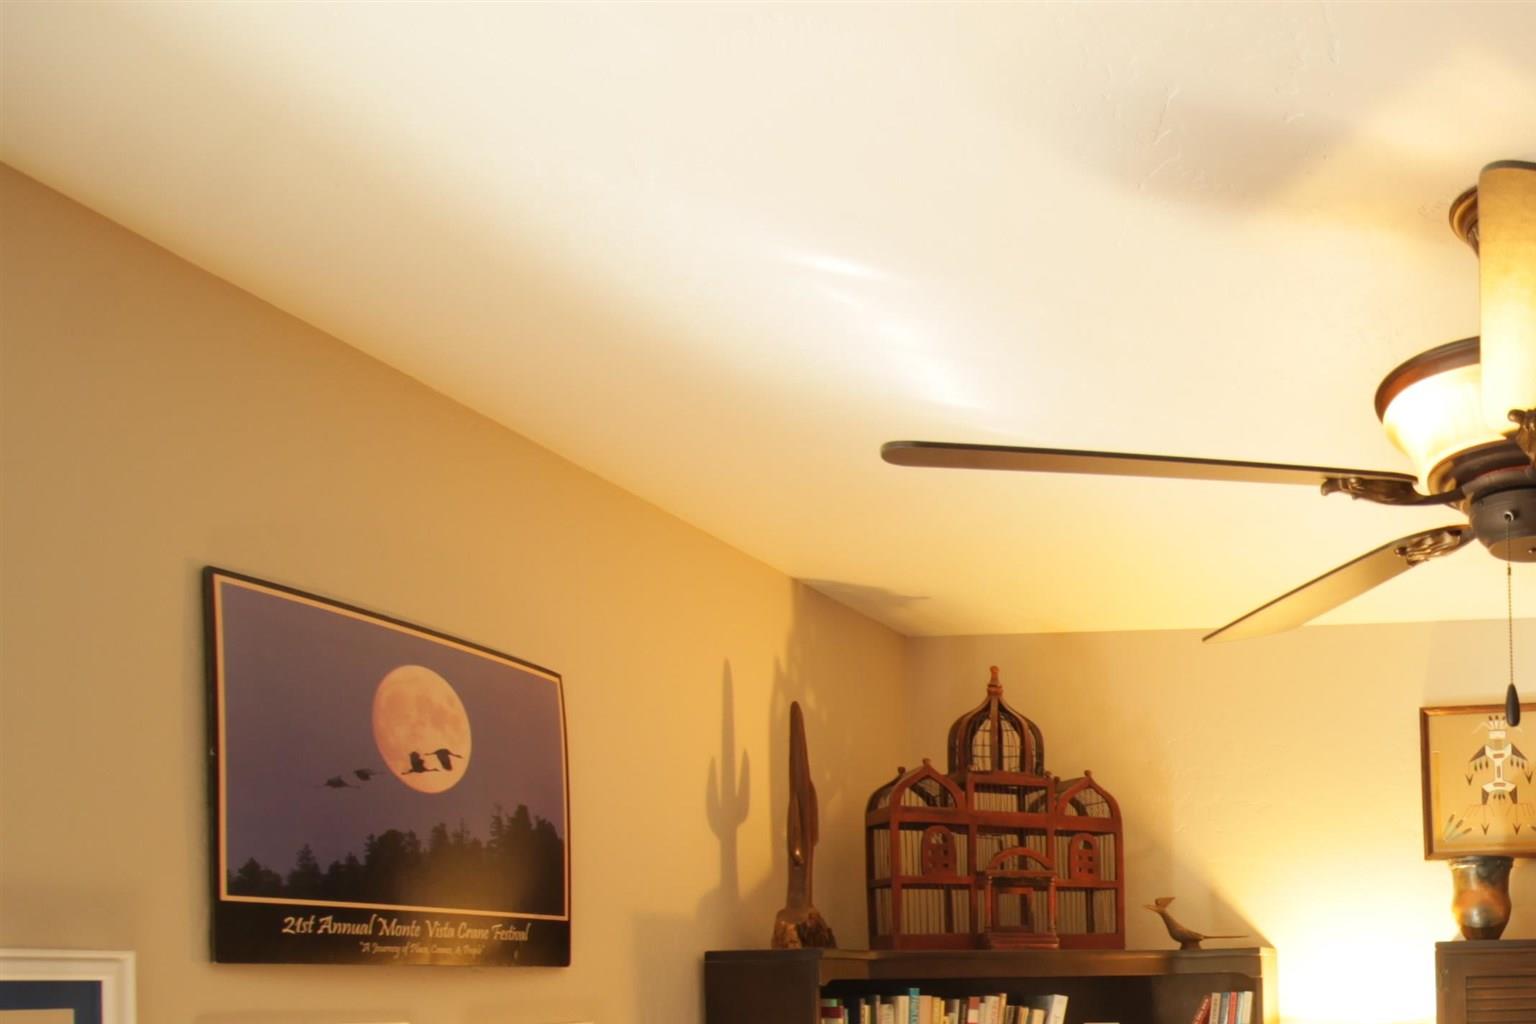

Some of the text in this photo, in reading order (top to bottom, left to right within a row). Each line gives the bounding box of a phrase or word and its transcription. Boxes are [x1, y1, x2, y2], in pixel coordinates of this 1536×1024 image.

[282, 914, 532, 942] 21st Annual Monte Vista Crane Festival
